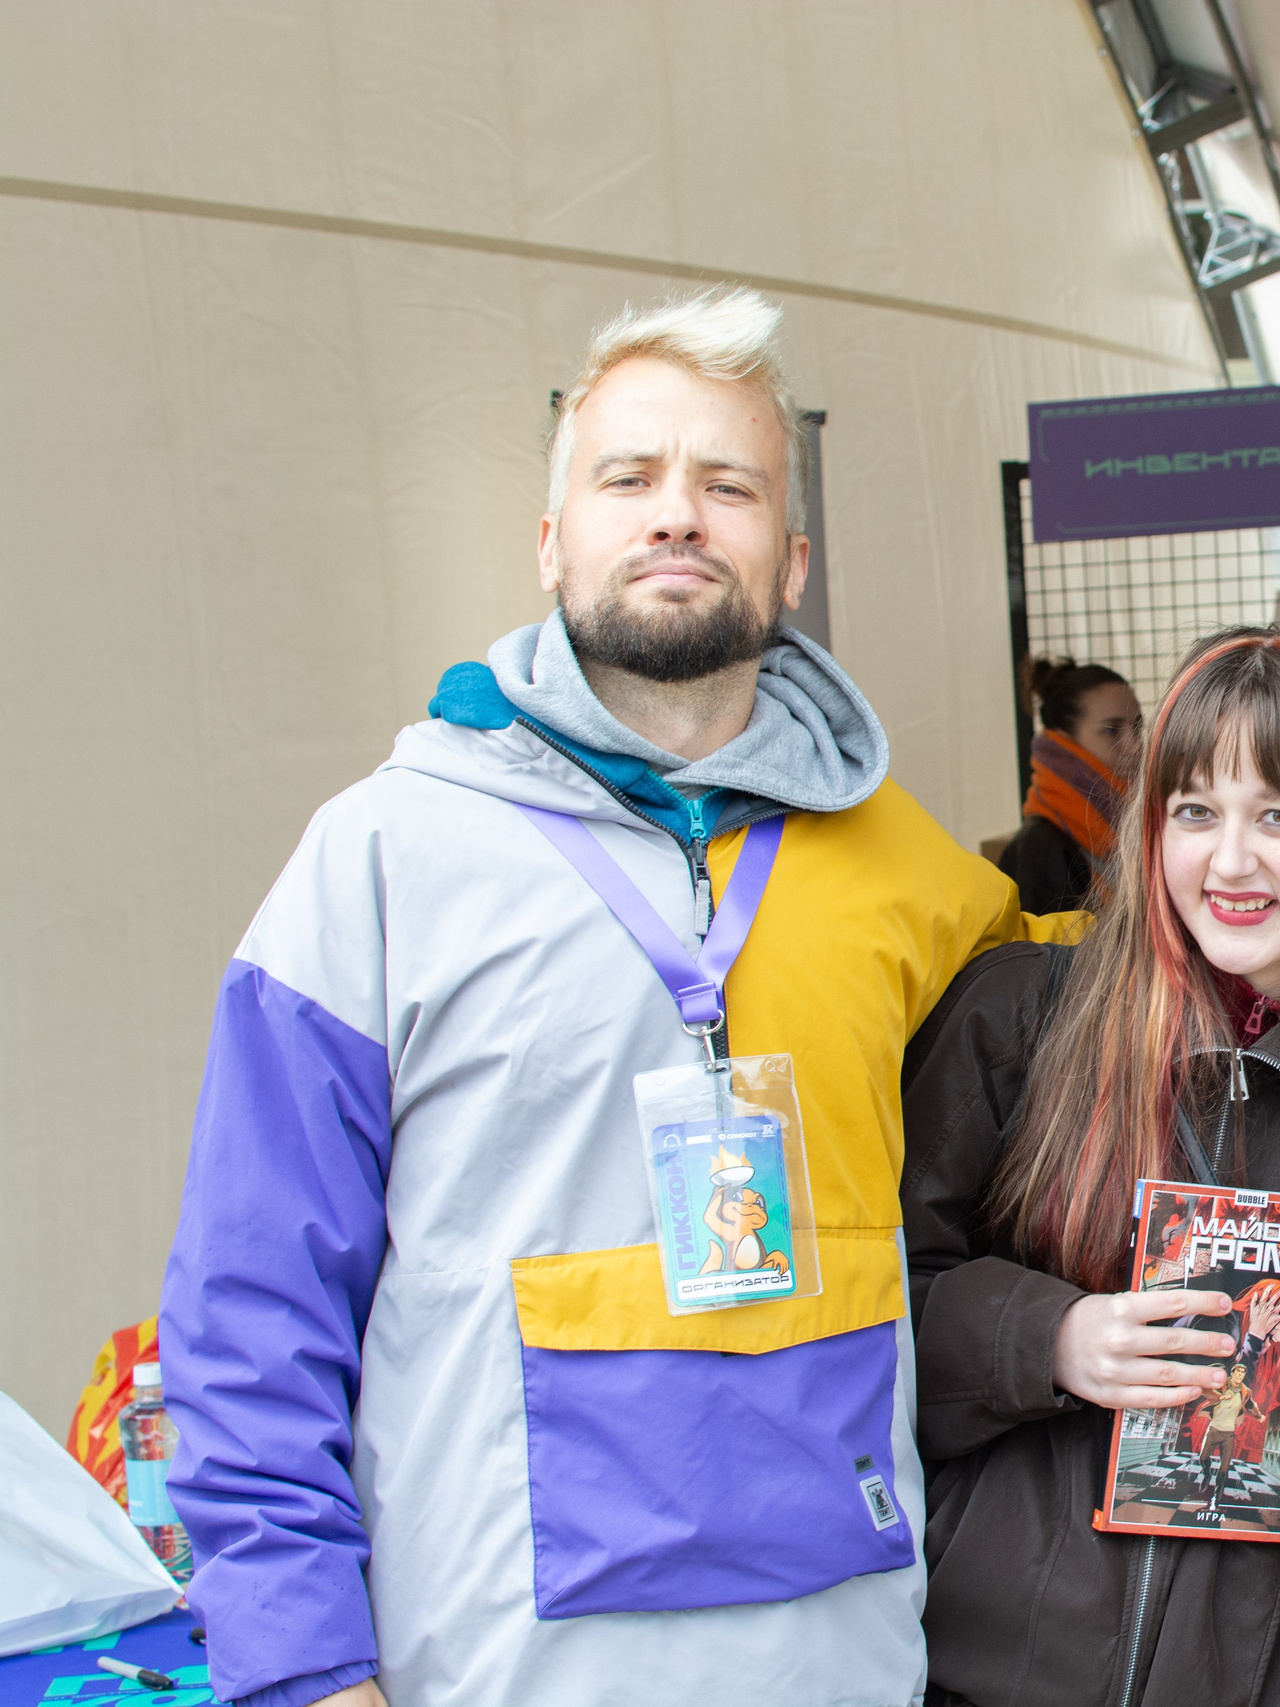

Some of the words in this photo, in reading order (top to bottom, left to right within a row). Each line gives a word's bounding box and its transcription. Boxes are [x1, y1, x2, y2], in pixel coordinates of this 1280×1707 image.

[1237, 1194, 1266, 1205] BUBBLE
[664, 1150, 697, 1270] ГИККОН
[681, 1275, 790, 1294] ОРГАНИЗАТОР
[1196, 1511, 1226, 1522] ИГРА
